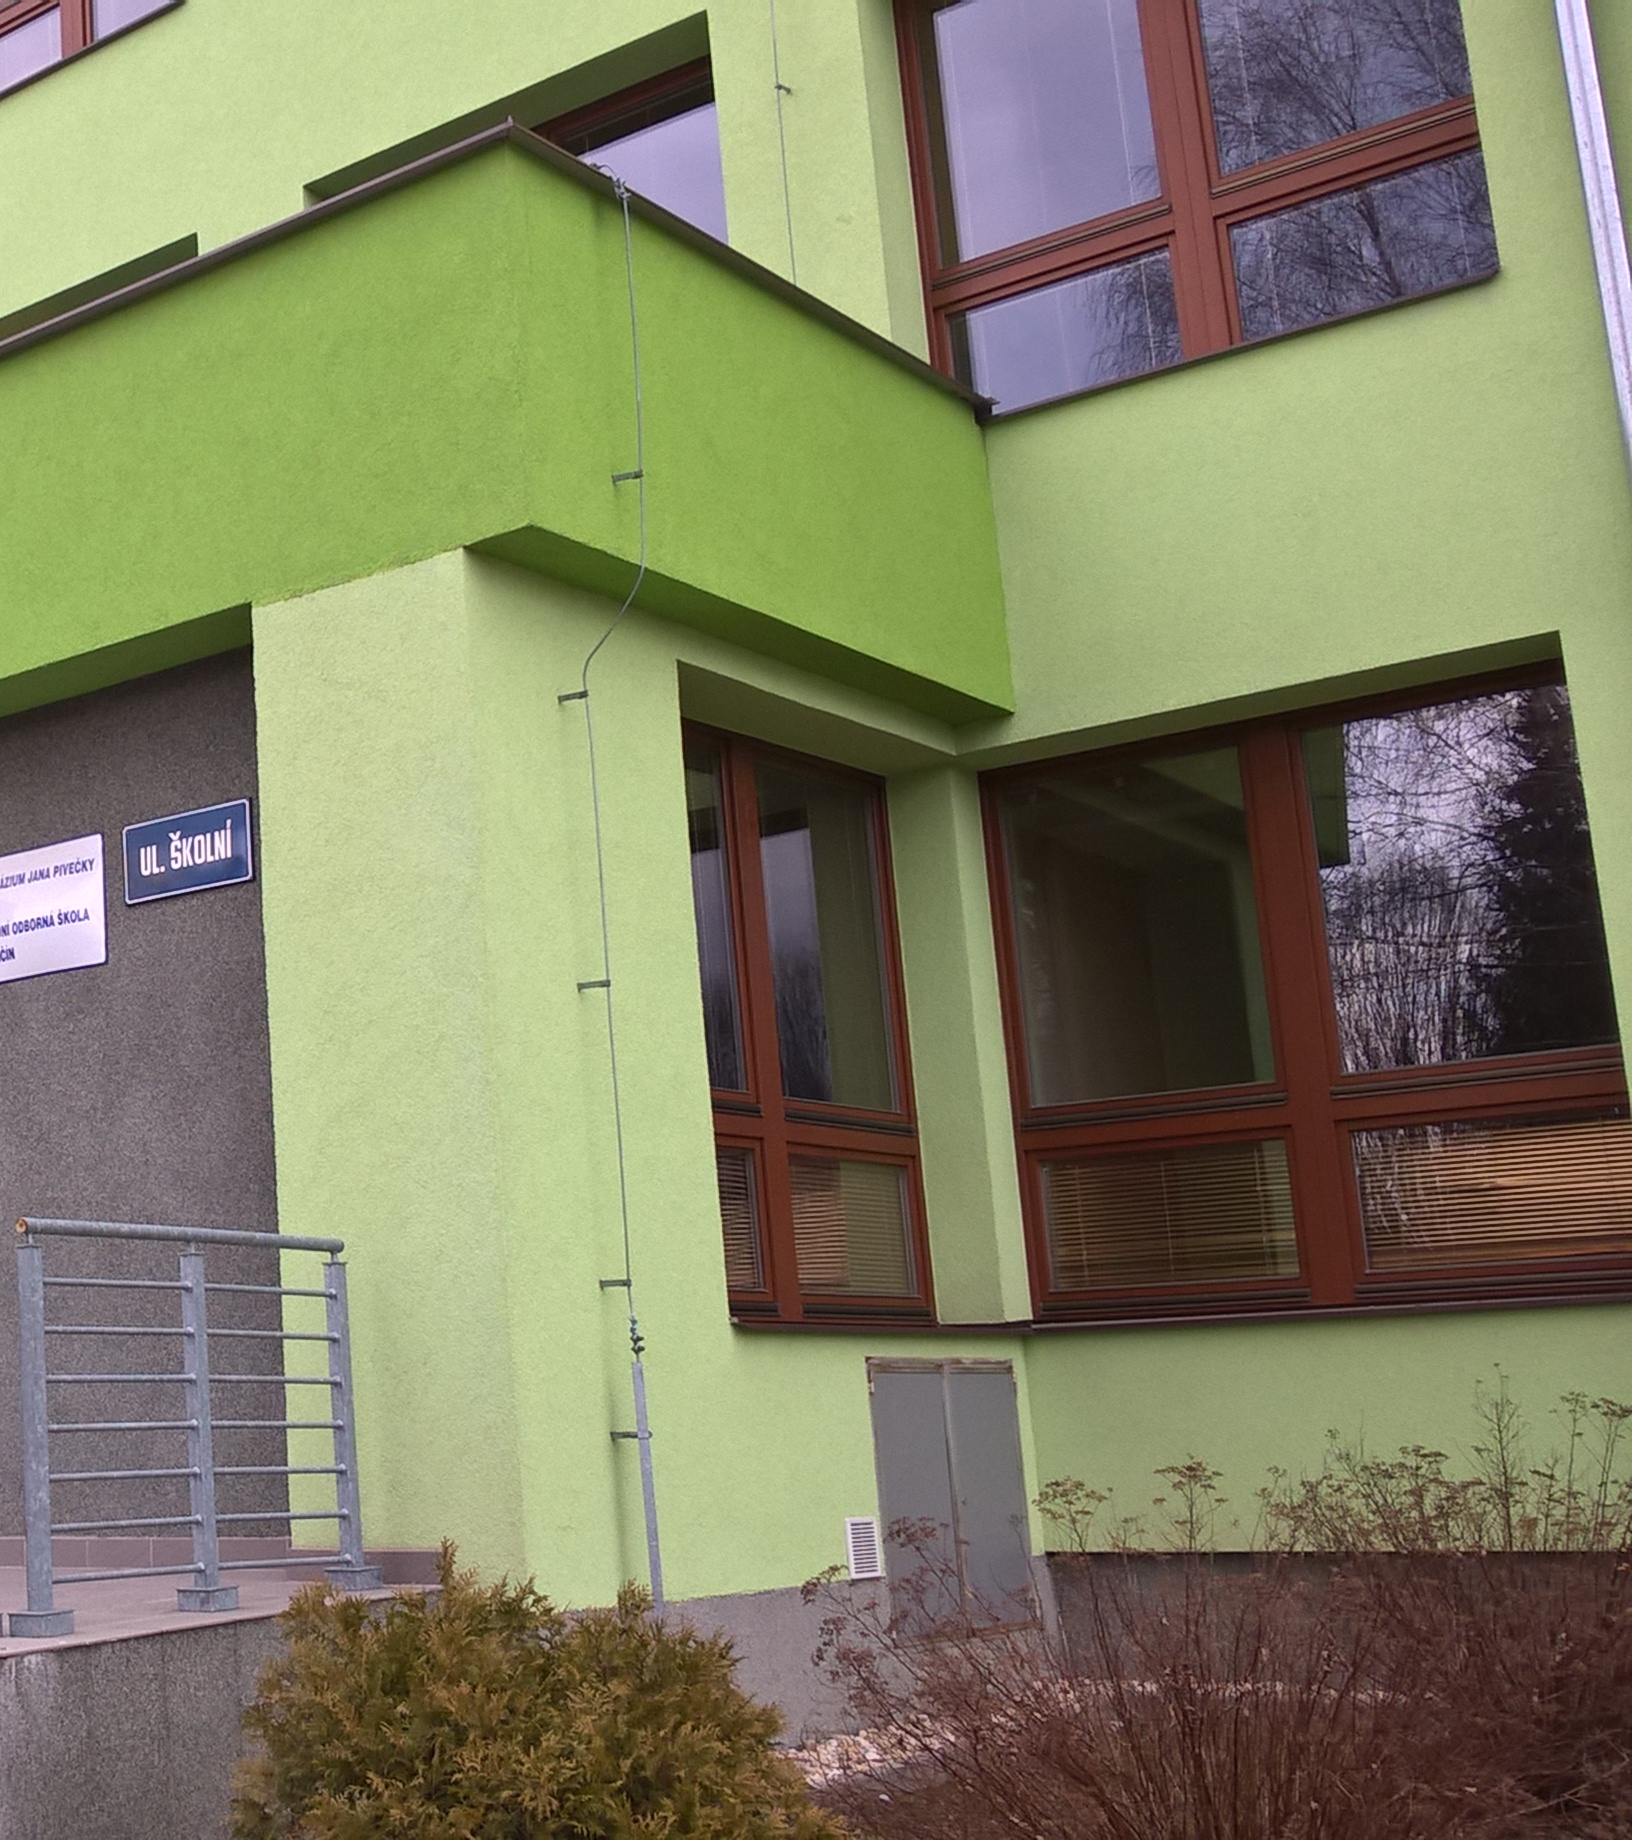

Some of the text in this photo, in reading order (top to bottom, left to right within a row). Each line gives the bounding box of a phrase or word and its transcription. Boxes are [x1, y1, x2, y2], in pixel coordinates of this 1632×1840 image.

[139, 818, 233, 877] UL. ŠKOLNÍ
[27, 867, 51, 884] JANA
[53, 857, 95, 878] PIVEČKY
[57, 908, 90, 926] ŠKOLA
